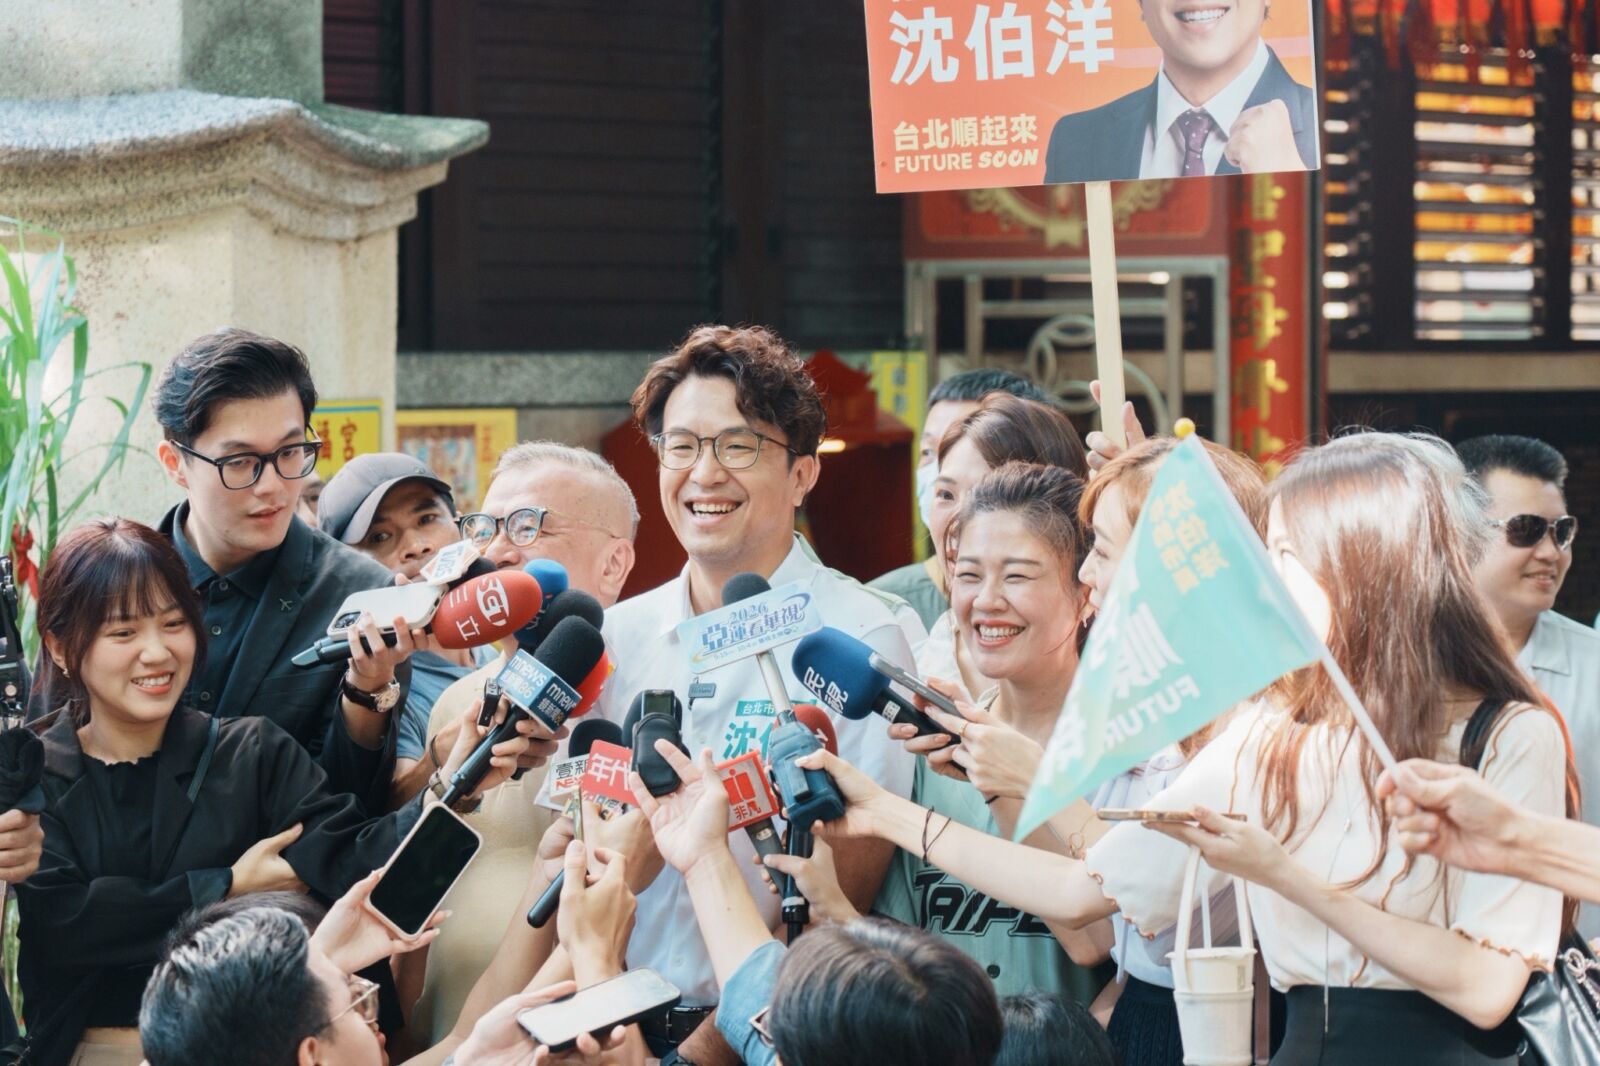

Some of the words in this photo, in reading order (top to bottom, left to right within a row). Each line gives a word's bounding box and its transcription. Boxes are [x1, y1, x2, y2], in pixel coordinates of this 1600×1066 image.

[889, 0, 1115, 85] 沈伯洋
[893, 113, 1039, 151] 台北順起來
[894, 152, 973, 174] FUTURE
[978, 148, 1039, 169] SOON
[448, 584, 481, 641] 三立
